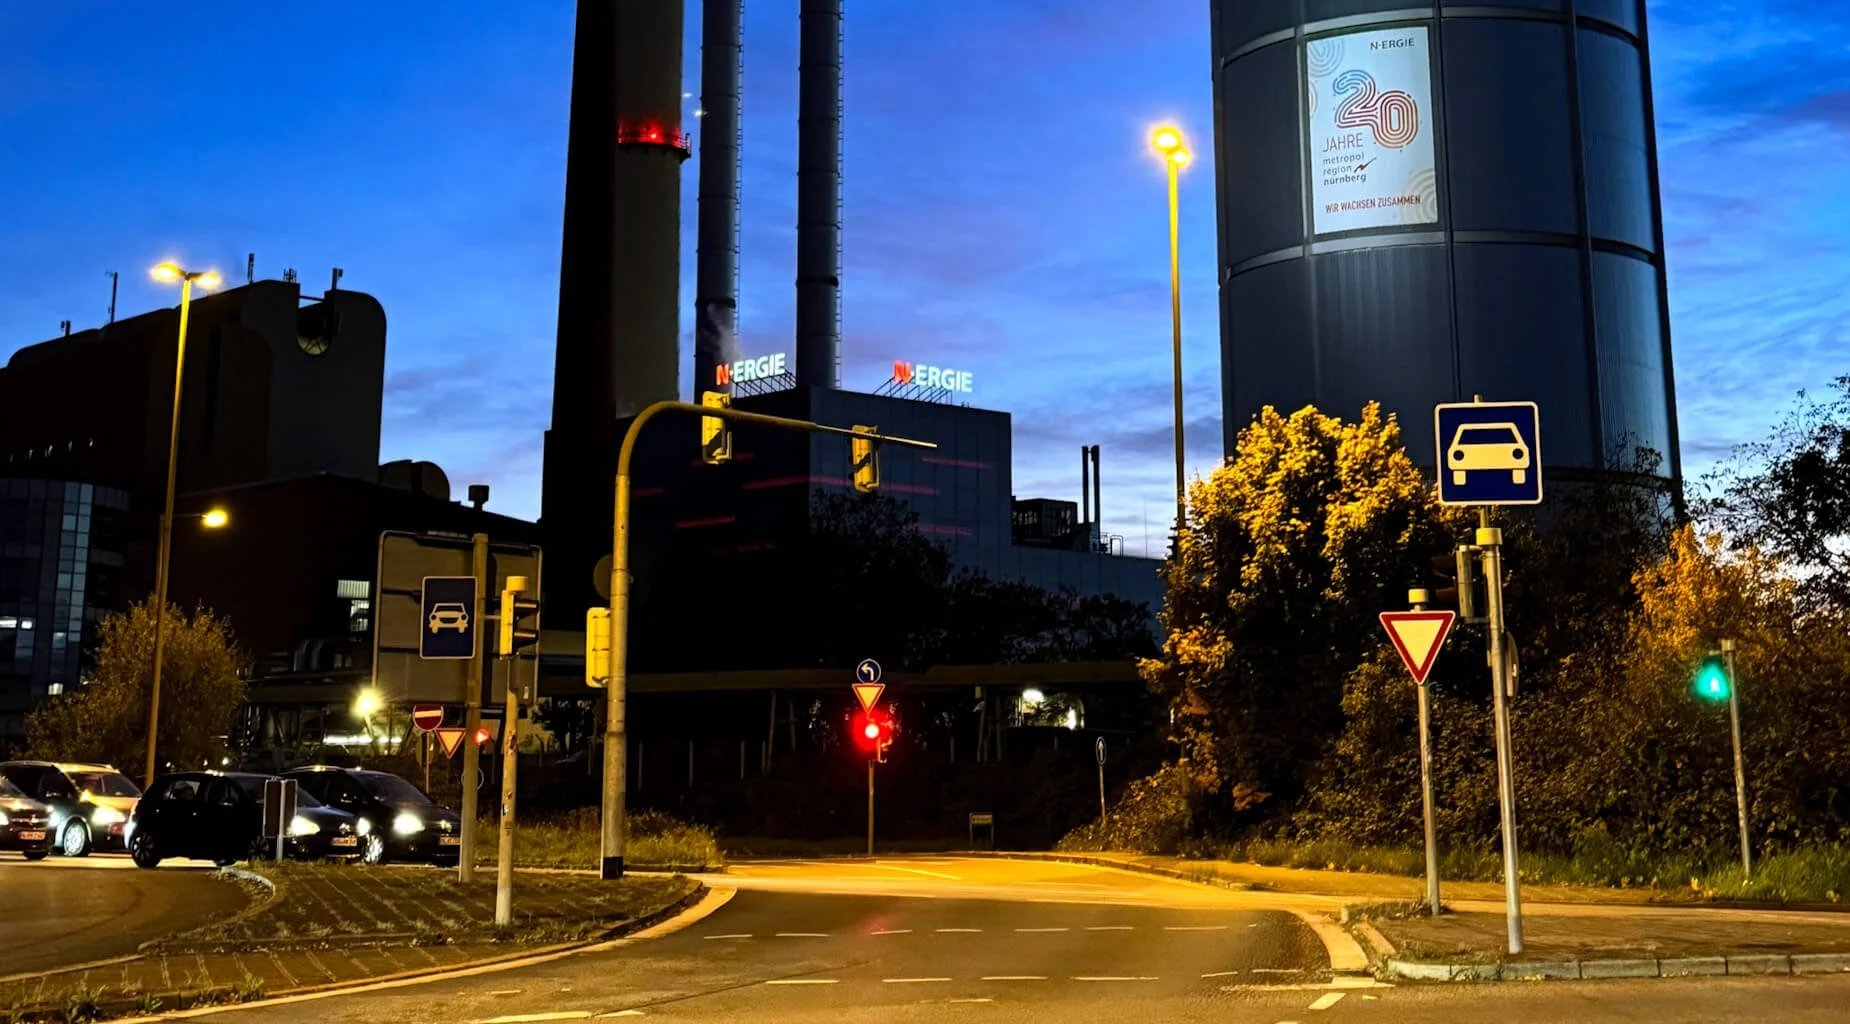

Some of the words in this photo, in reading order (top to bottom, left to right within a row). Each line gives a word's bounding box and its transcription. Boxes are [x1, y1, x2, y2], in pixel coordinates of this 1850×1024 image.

[1332, 69, 1419, 149] 20
[1322, 133, 1364, 153] JAHRE
[1322, 152, 1365, 166] metropol
[1323, 165, 1352, 177] region
[1323, 173, 1367, 186] nürnberg
[1325, 202, 1340, 214] WIR
[1340, 197, 1376, 212] WACHSEN
[1377, 194, 1422, 208] ZUSAMMEN
